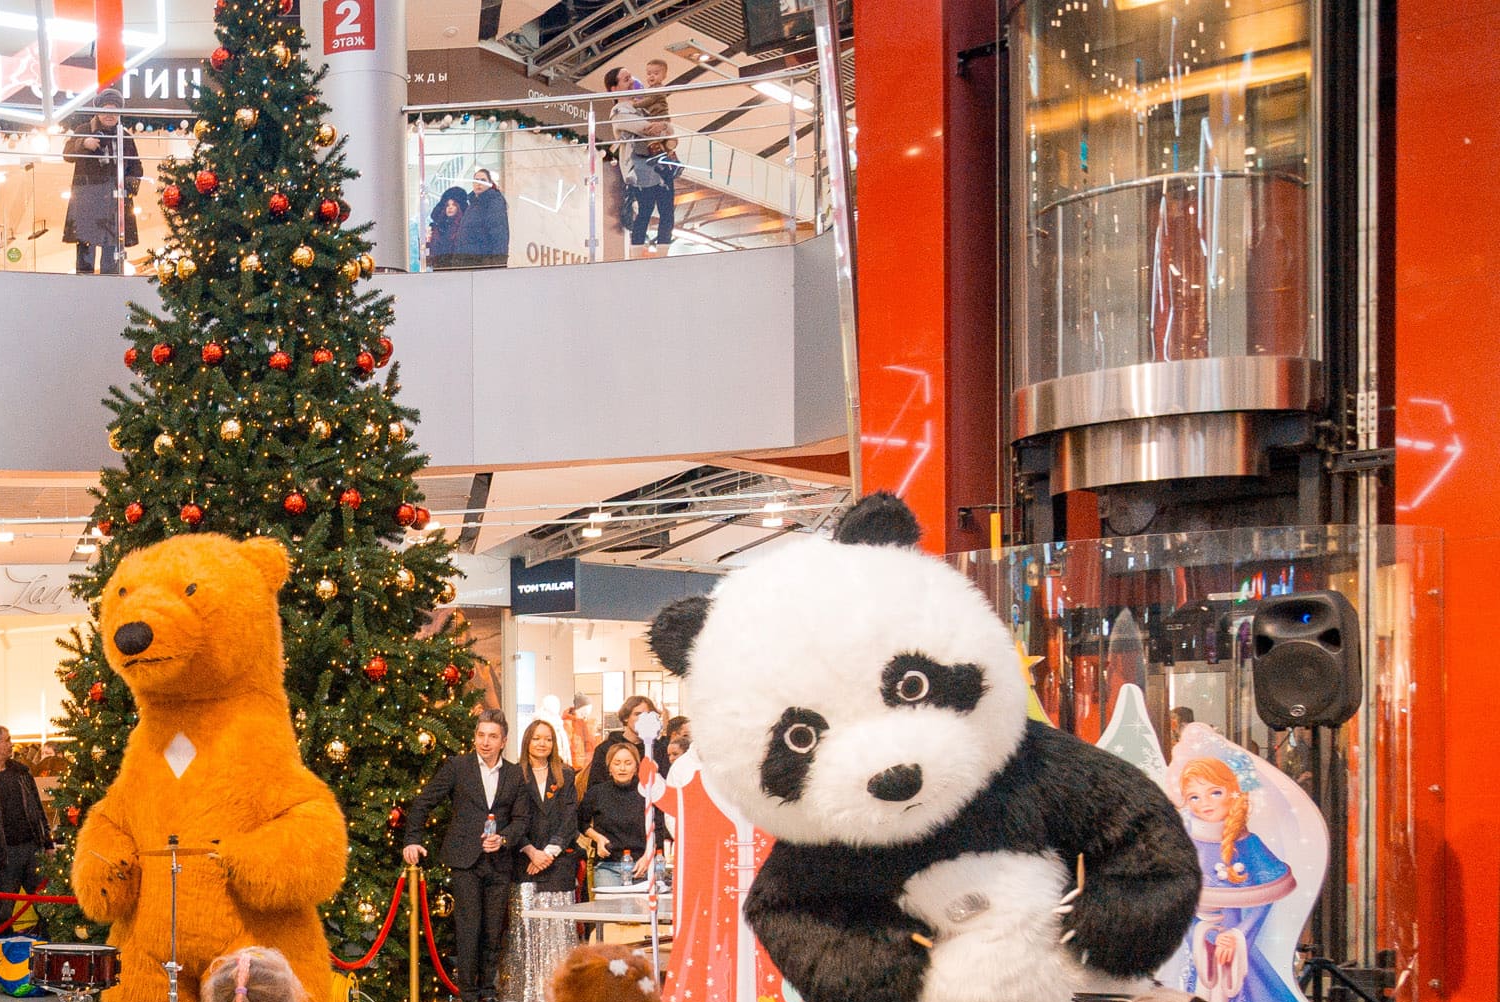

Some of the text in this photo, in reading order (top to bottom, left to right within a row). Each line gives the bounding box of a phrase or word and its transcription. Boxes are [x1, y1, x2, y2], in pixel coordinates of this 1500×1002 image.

[335, 0, 361, 36] 2
[332, 36, 365, 49] этаж
[407, 72, 448, 84] ежды
[517, 584, 539, 594] TOM
[539, 581, 574, 592] TAILOR
